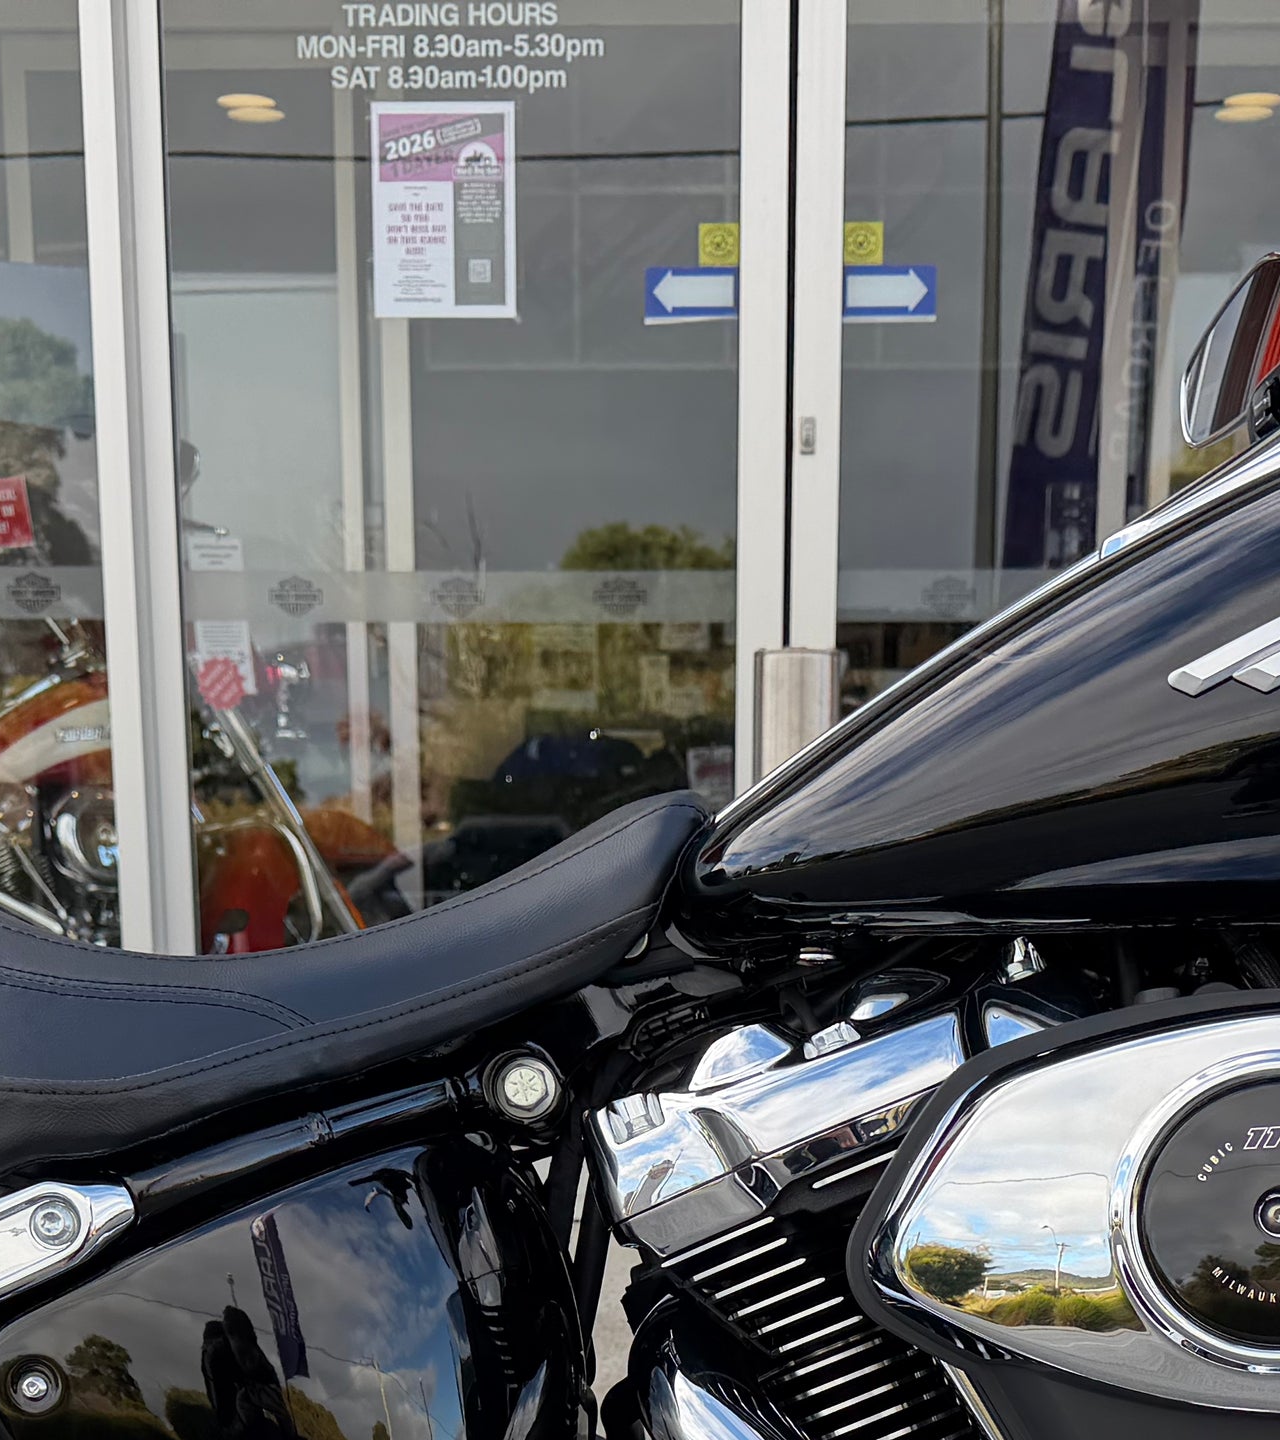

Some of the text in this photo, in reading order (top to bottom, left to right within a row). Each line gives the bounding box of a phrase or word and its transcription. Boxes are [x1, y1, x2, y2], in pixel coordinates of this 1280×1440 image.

[342, 2, 558, 27] TRADING HOURS
[297, 33, 605, 62] MON-FRI 8.30am-5.30pm
[331, 66, 380, 89] SAT
[385, 130, 436, 160] 2026
[1197, 1142, 1234, 1182] CUBIC
